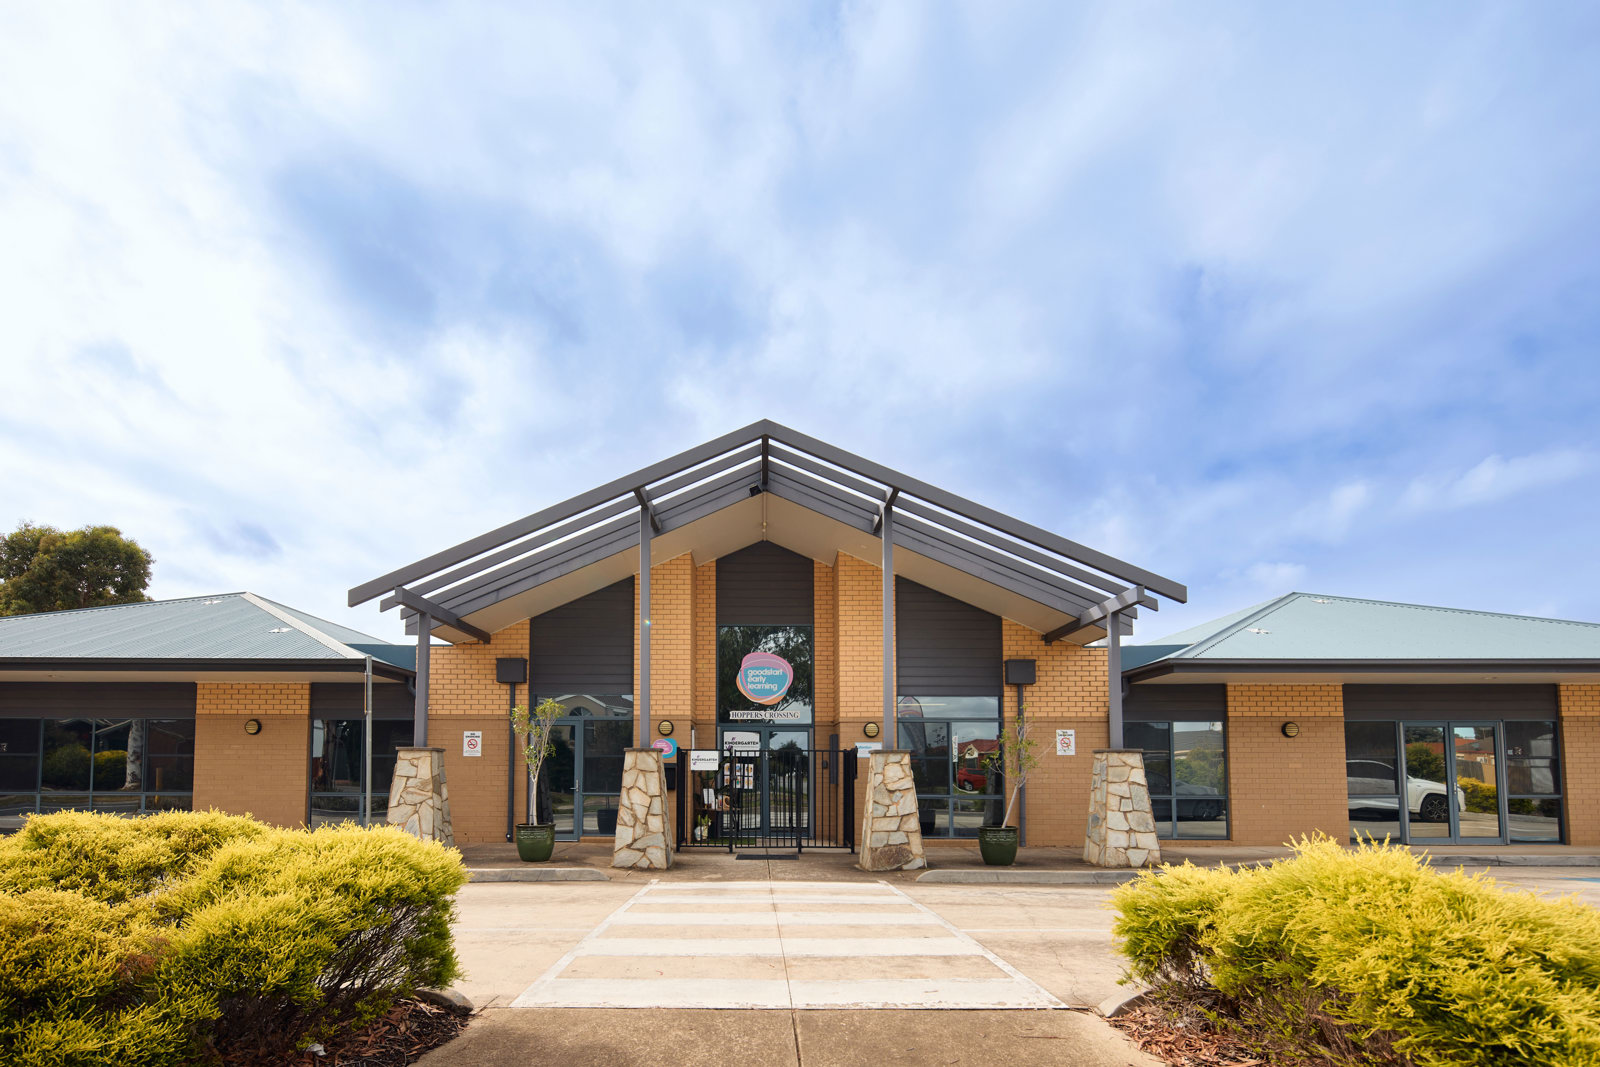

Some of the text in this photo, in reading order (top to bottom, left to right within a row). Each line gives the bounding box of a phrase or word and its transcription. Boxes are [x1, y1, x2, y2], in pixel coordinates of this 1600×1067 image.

[747, 668, 783, 678] goodstart
[747, 675, 767, 684] early
[747, 682, 778, 691] learning
[731, 711, 799, 719] HOPPERS CROSSING
